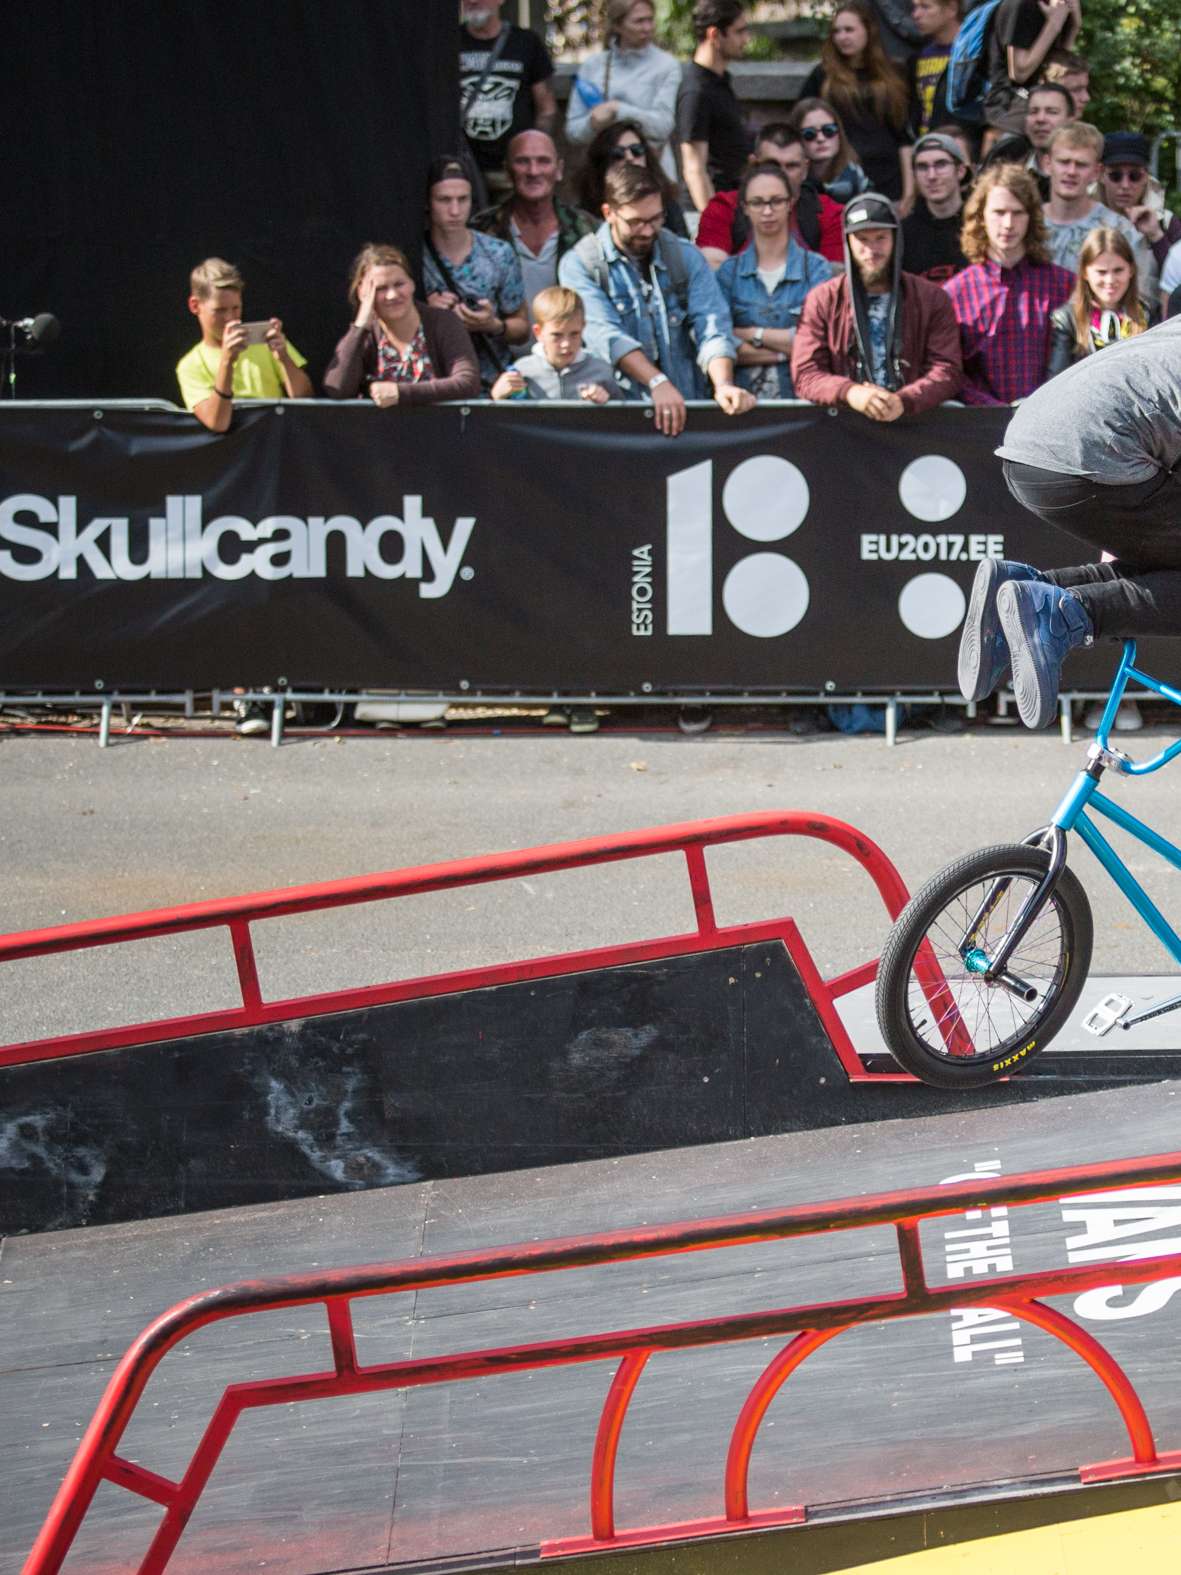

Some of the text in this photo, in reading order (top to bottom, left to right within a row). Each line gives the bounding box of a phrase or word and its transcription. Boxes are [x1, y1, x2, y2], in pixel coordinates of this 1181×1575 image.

[860, 533, 1005, 561] EU2017.EE
[631, 543, 653, 636] ESTONIA
[992, 1040, 1036, 1072] MAXXIS
[944, 1219, 1014, 1279] THE
